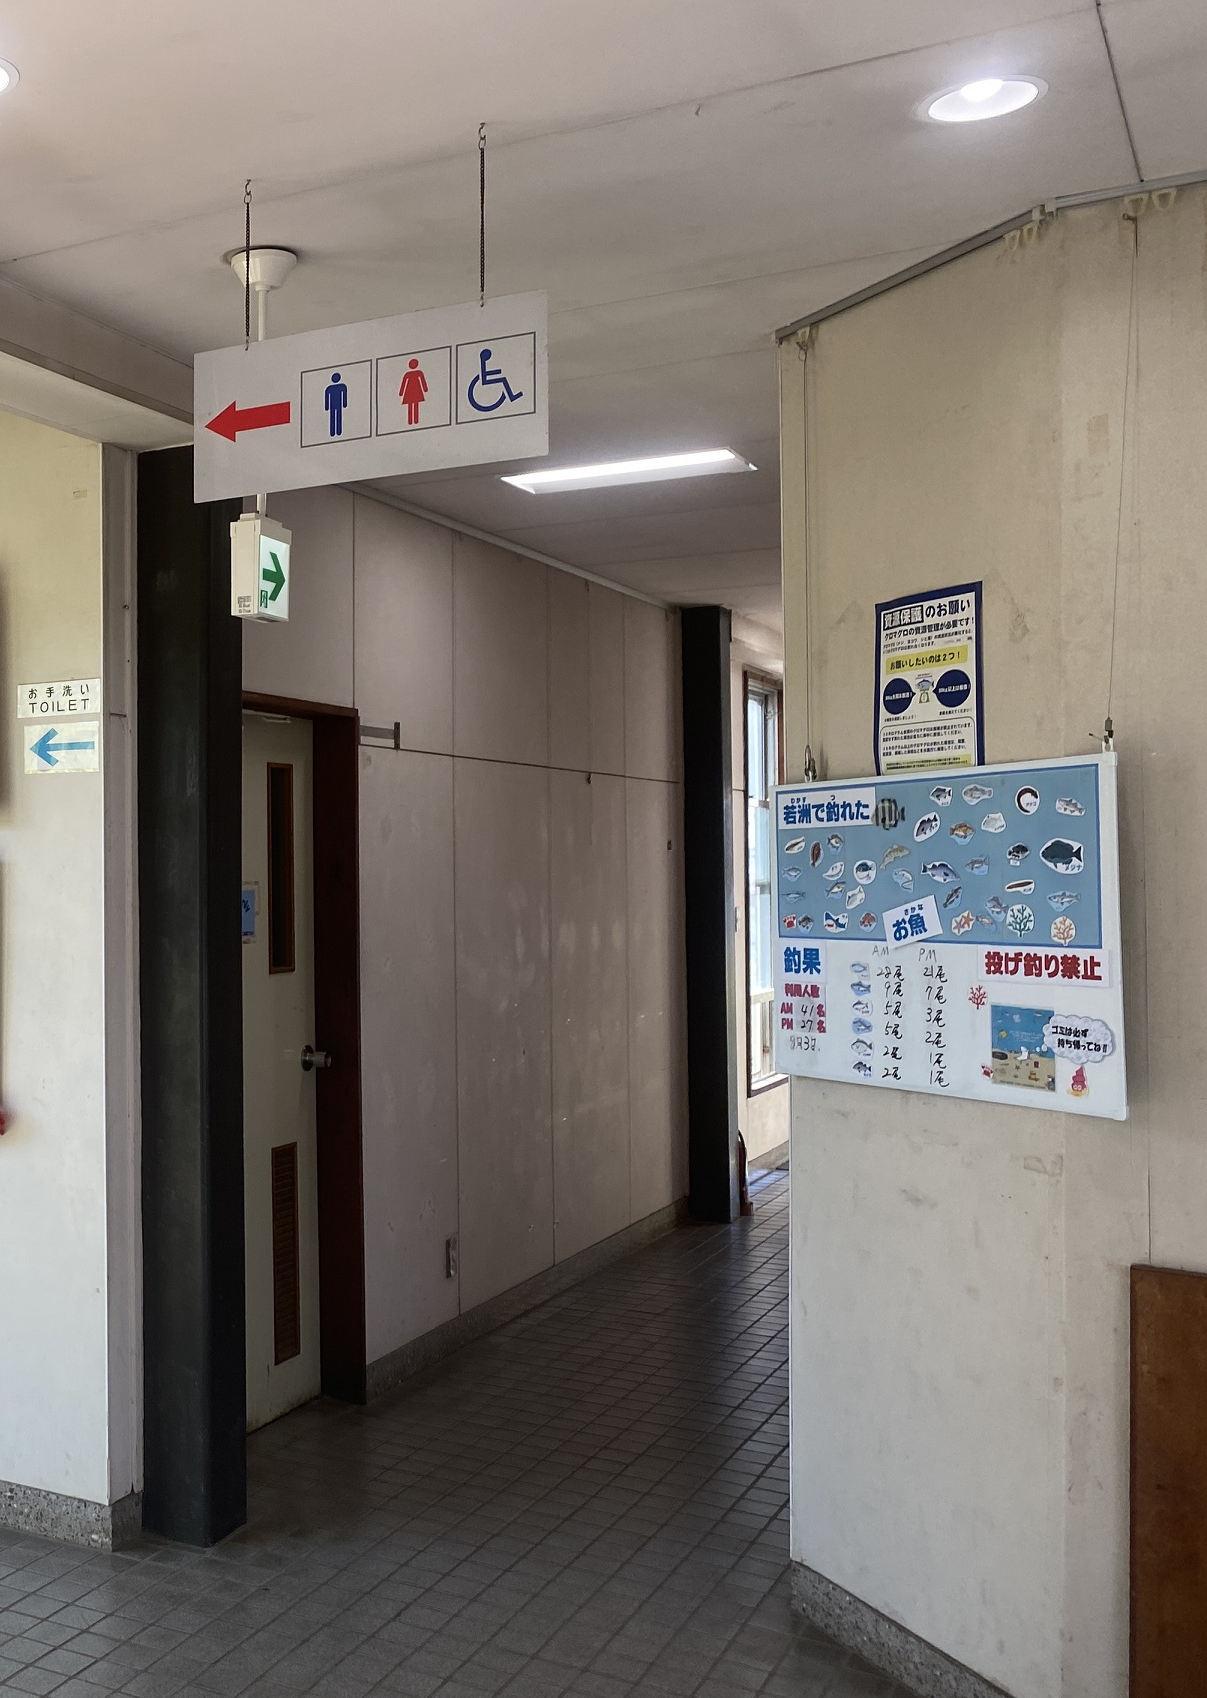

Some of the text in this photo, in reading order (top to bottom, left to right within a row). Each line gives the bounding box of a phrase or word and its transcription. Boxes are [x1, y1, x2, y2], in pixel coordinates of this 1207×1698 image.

[28, 683, 90, 700] お手洗い
[28, 699, 90, 713] TOILET
[783, 800, 870, 825] 若洲で釣れた
[892, 913, 928, 942] お魚
[783, 946, 821, 975] 釣果
[918, 948, 938, 963] PM
[984, 951, 1103, 981] 投げ釣り禁止
[780, 1002, 793, 1015] AM
[781, 1017, 793, 1030] PM
